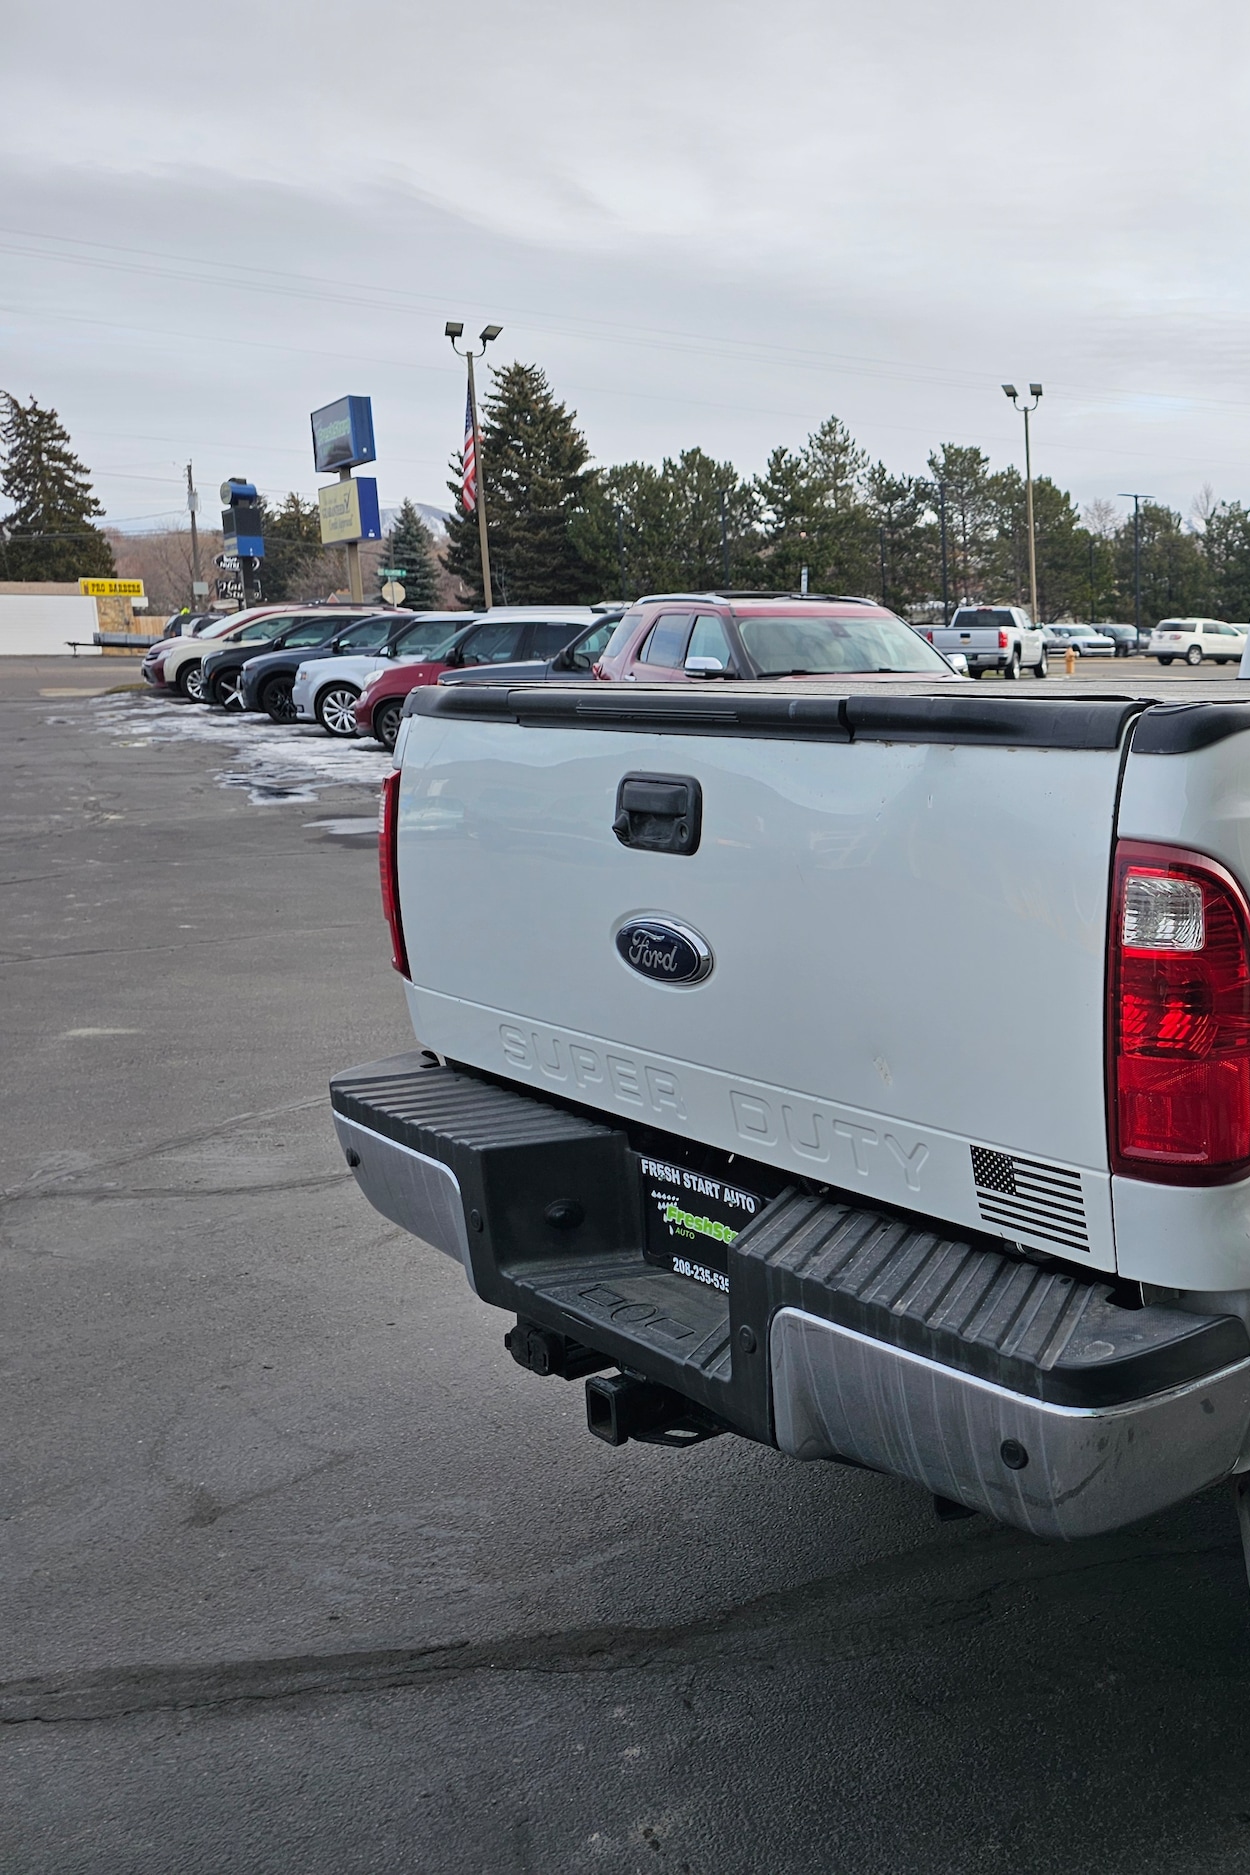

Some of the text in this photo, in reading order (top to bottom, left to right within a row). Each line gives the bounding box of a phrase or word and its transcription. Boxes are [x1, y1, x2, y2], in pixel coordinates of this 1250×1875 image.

[91, 583, 141, 593] PRO BARBERS
[628, 929, 678, 972] Ford
[498, 1023, 931, 1192] SUPER DUTY
[641, 1158, 757, 1214] FRESH START AUTO
[675, 1227, 696, 1240] AUTO
[672, 1256, 730, 1294] 208-235-535
